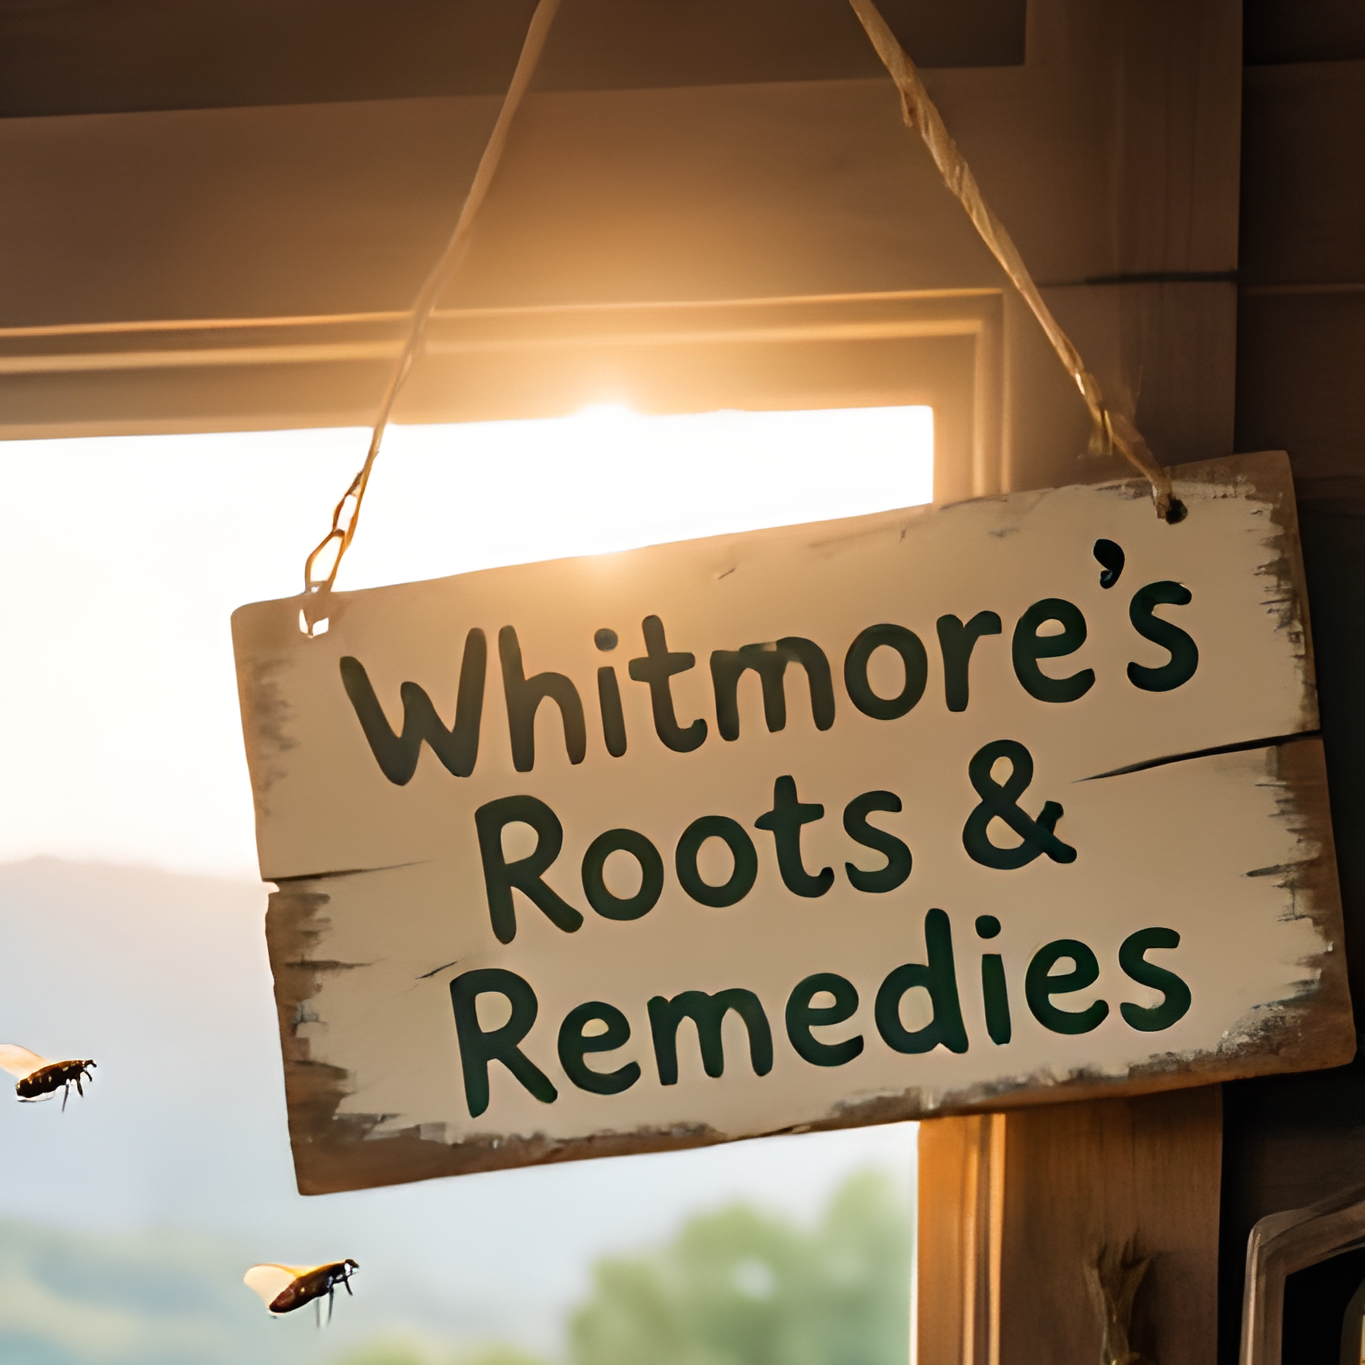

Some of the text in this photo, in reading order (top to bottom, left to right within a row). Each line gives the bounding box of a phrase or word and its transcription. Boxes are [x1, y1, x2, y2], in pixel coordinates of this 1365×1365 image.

[339, 538, 1200, 787] Whitmore's
[474, 738, 1078, 946] Roots &
[449, 907, 1193, 1119] Remedies
